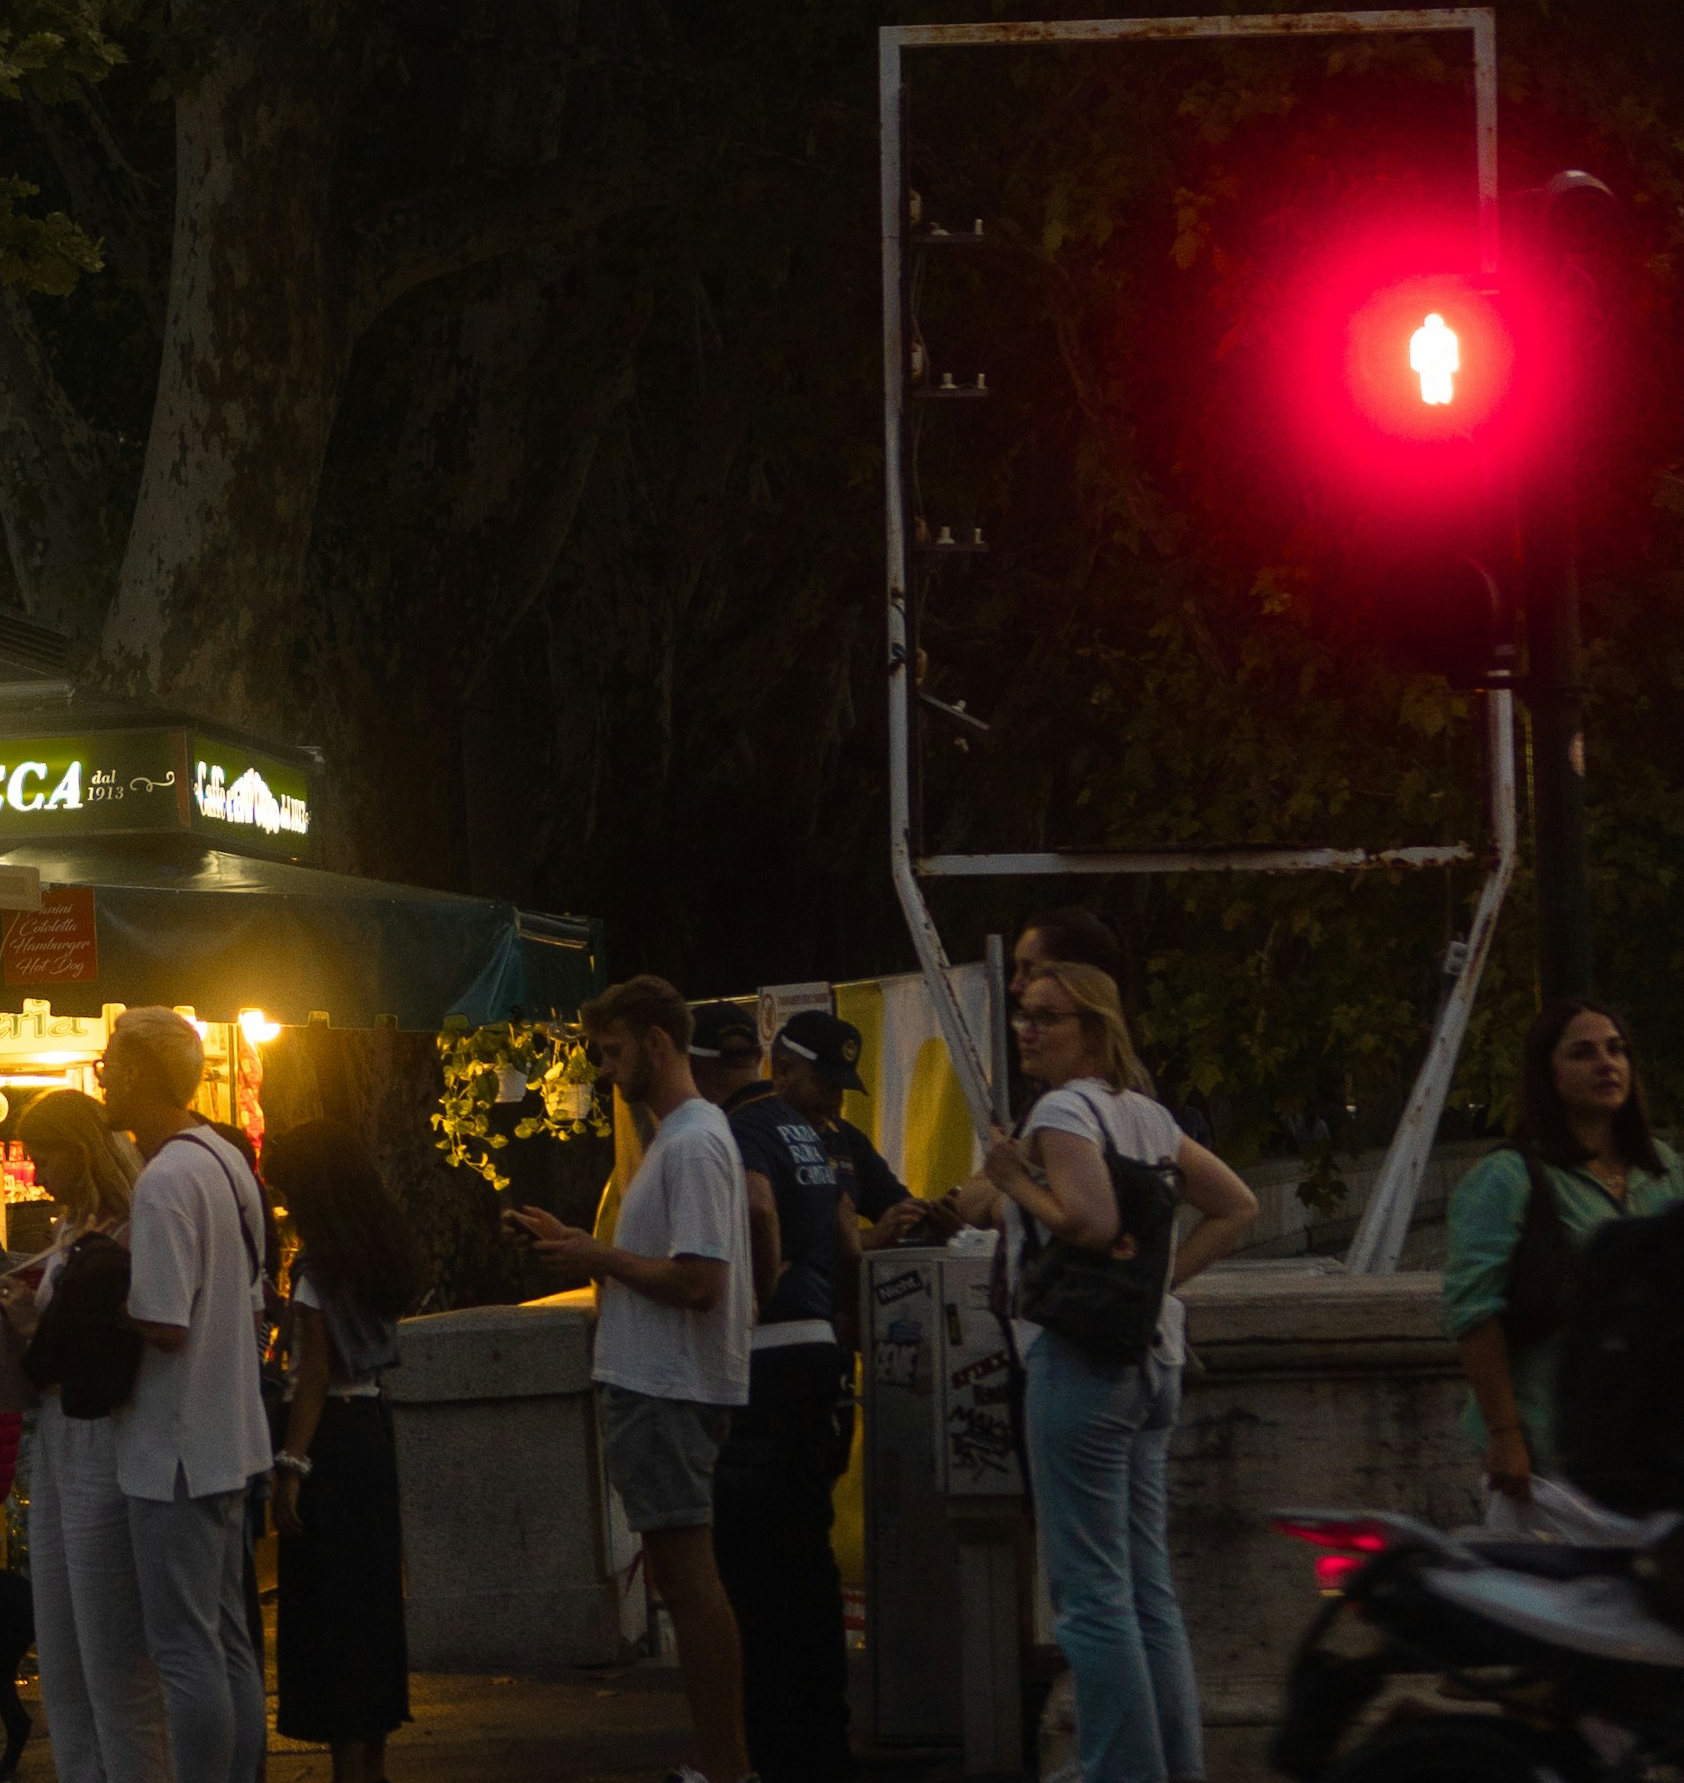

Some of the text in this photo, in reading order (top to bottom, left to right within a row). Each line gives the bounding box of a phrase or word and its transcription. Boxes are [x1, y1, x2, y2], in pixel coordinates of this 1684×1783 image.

[91, 769, 116, 785] dal
[87, 786, 124, 801] 1913
[39, 901, 75, 915] anini
[9, 937, 91, 956] Hamburger
[16, 955, 84, 978] Hot Dog
